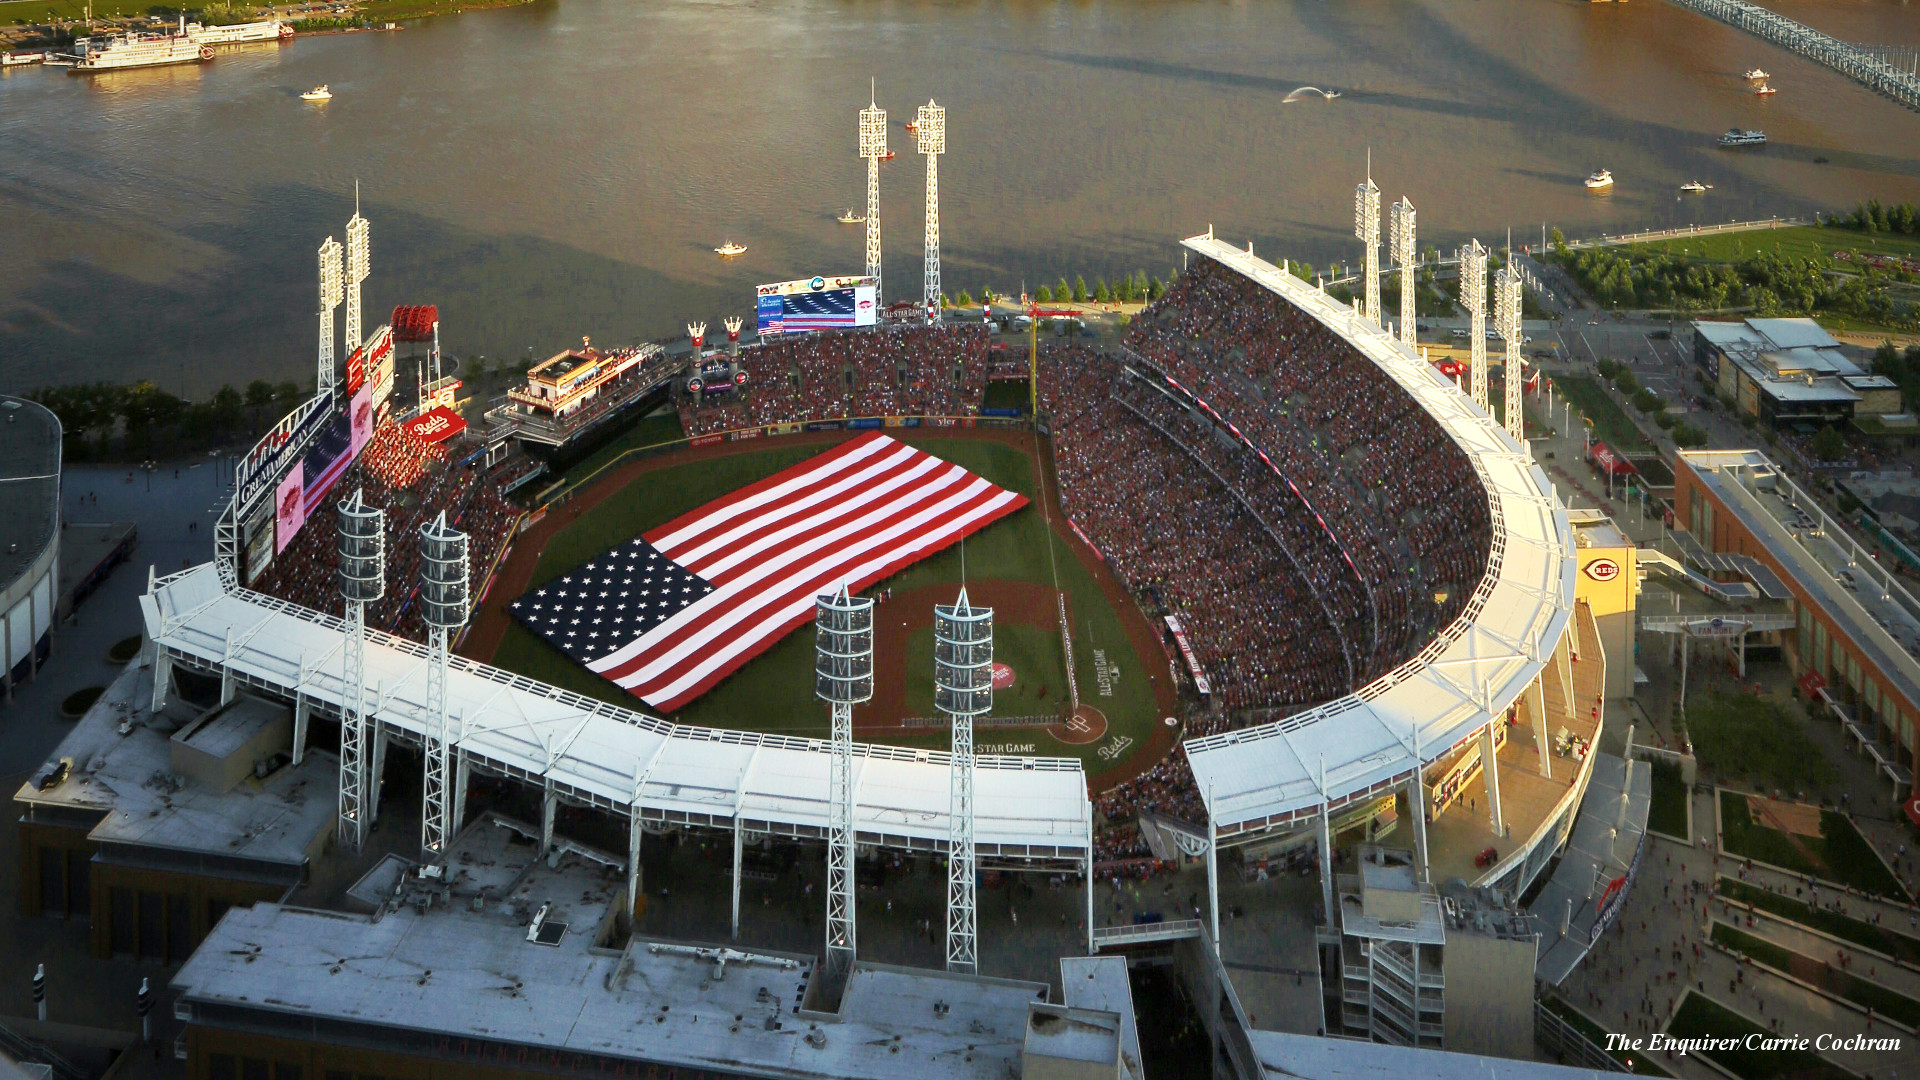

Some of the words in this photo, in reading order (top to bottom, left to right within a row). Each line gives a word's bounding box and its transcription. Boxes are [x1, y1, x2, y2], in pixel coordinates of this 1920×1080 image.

[413, 415, 447, 436] Reds
[701, 436, 722, 444] TOYOTA
[241, 463, 270, 503] GREAT
[1595, 567, 1619, 575] REDS
[1698, 626, 1713, 635] FAN
[1006, 743, 1036, 753] GAME
[1098, 735, 1133, 760] Reds
